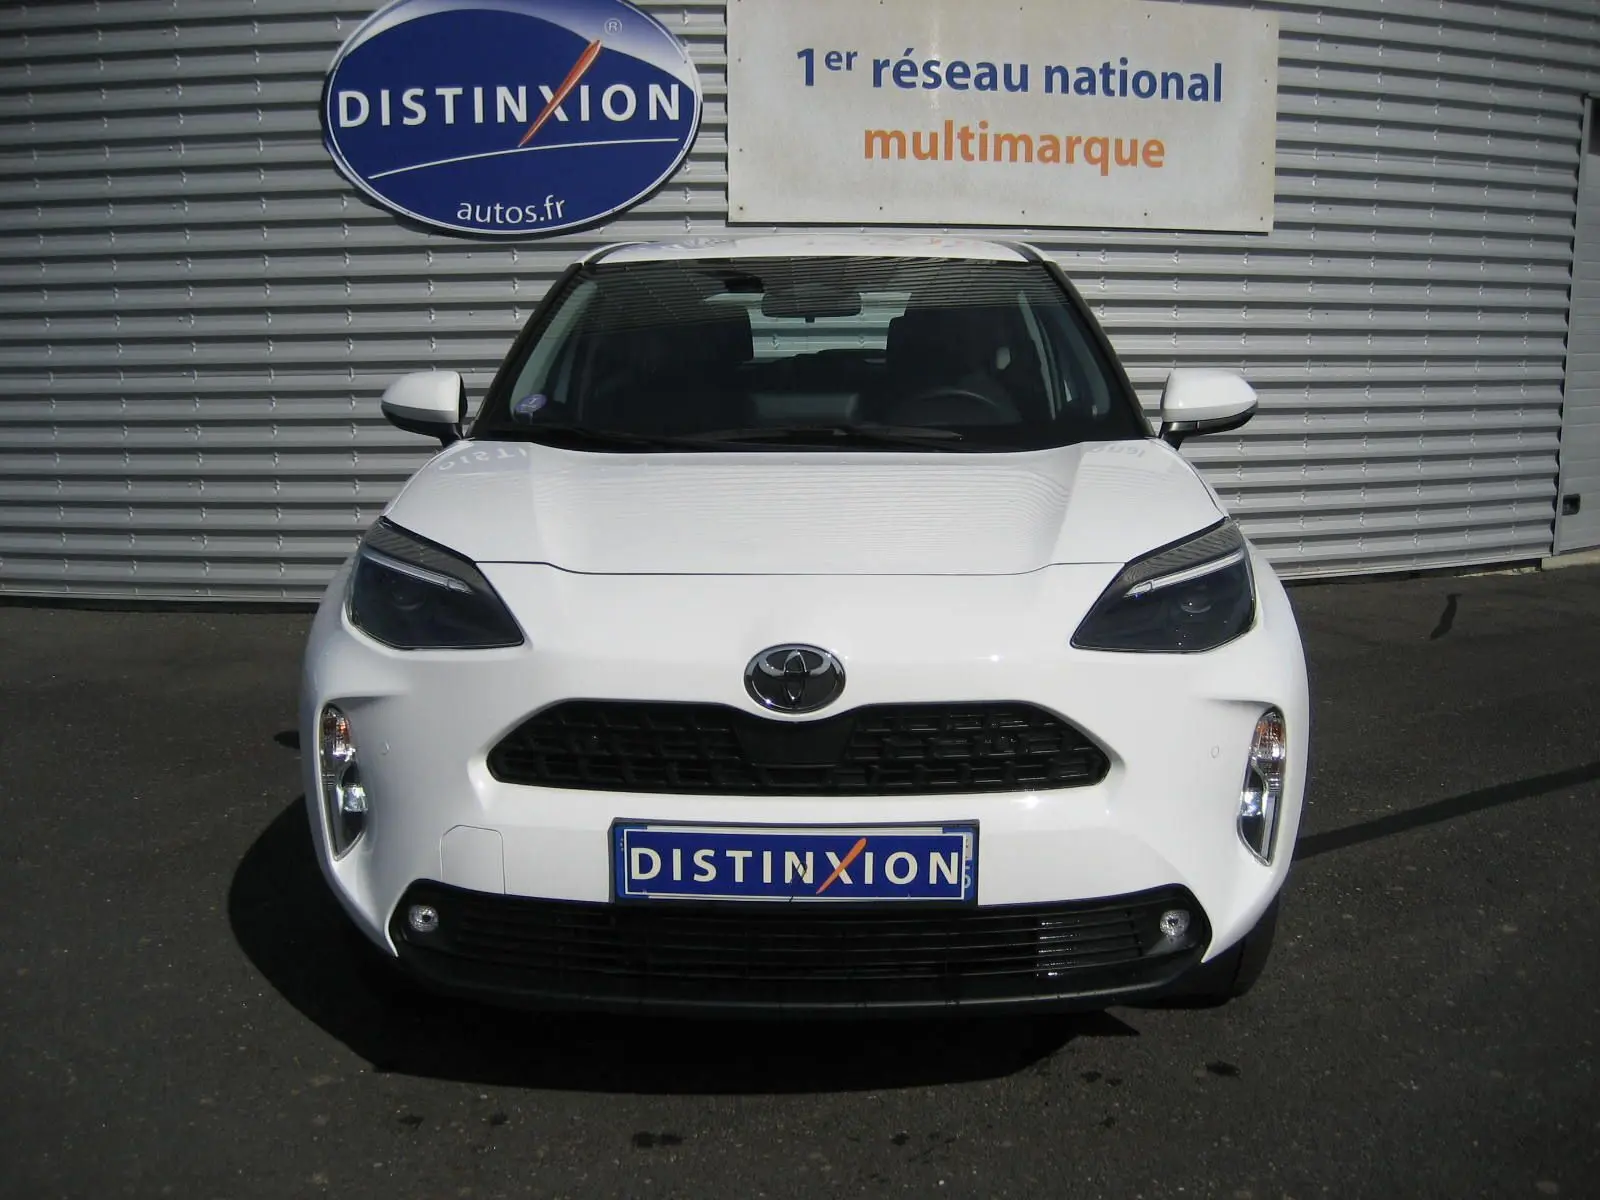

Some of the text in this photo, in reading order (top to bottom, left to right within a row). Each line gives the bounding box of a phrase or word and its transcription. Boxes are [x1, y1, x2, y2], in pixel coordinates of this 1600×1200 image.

[797, 47, 1223, 103] 1er réseau national
[338, 83, 681, 128] DISTINXION
[864, 119, 1166, 177] multimarque
[457, 194, 566, 225] autos.fr
[630, 847, 959, 886] DISTINXION
